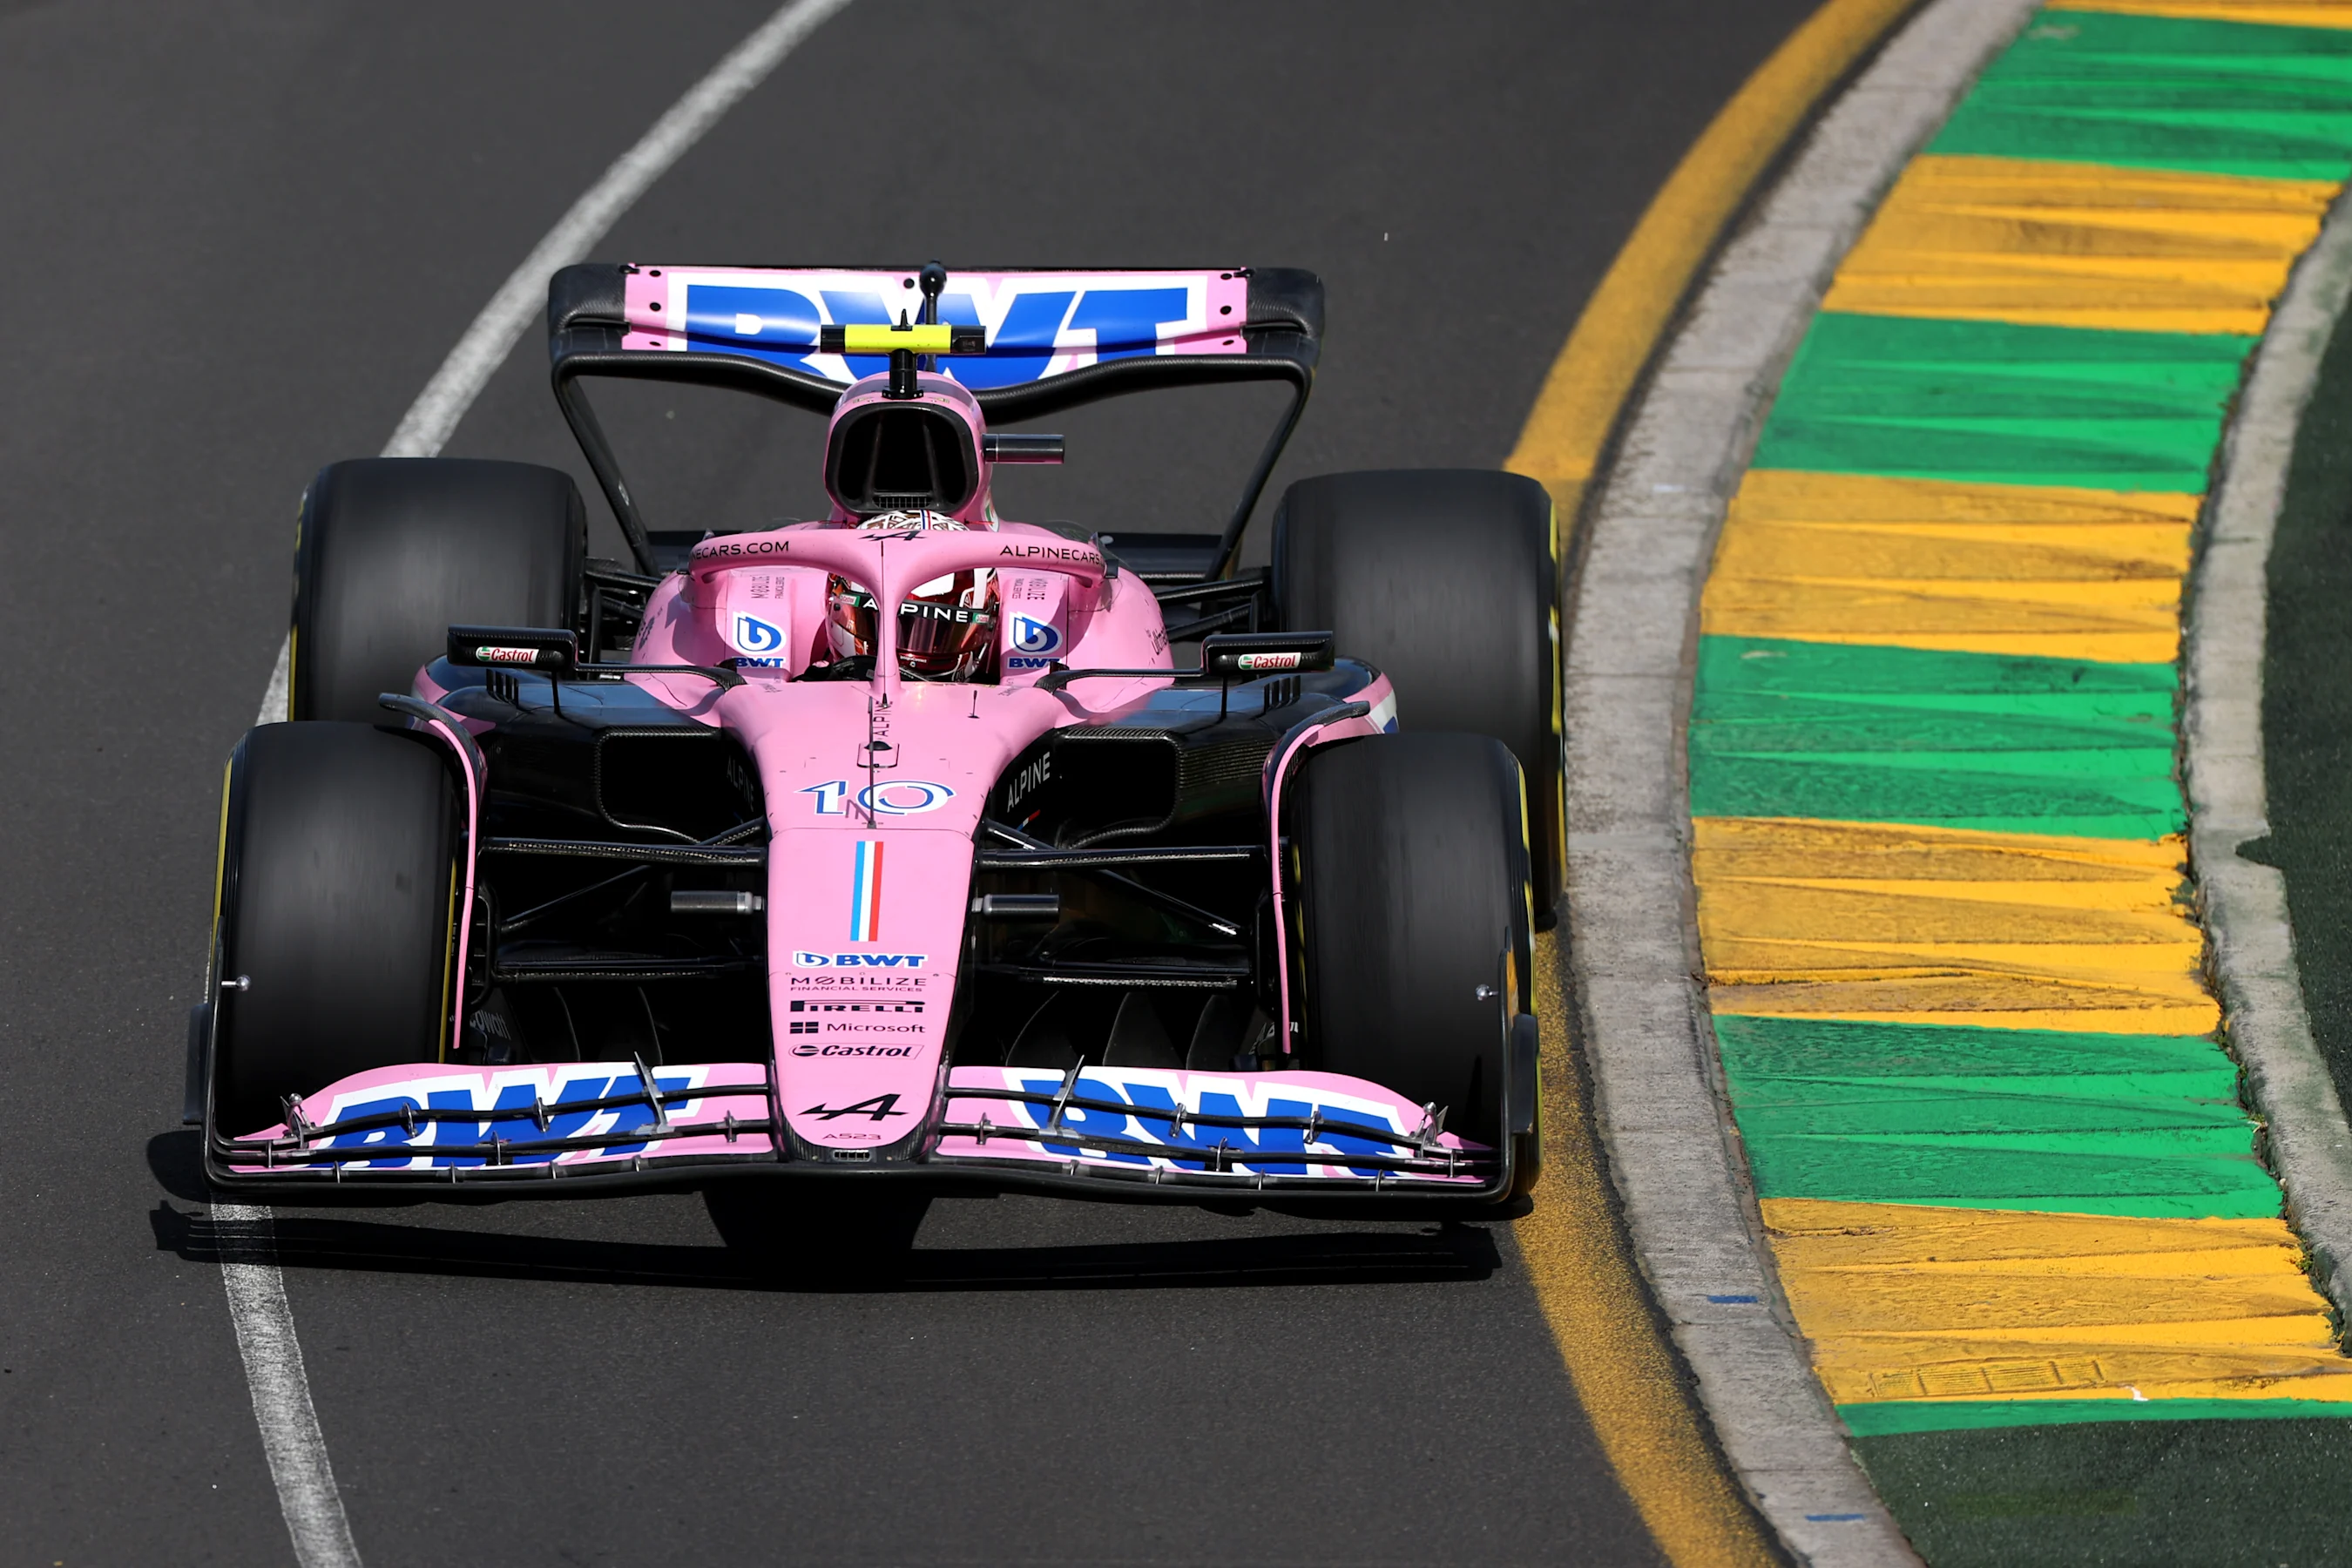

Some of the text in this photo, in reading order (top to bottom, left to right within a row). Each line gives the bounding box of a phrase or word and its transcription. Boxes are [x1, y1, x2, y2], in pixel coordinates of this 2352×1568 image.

[686, 284, 1188, 389] BWT
[862, 598, 969, 623] APINE
[491, 648, 534, 662] Castrol
[1254, 655, 1295, 669] Castrol
[736, 657, 783, 668] BWT
[1007, 751, 1051, 813] ALPINE
[795, 781, 955, 814] 10
[836, 954, 925, 967] BWT
[790, 999, 926, 1013] PIRELLI
[827, 1023, 926, 1034] Microsoft
[821, 1045, 913, 1058] Castrol
[308, 1074, 693, 1168] BWT
[1020, 1078, 1401, 1176] BWT
